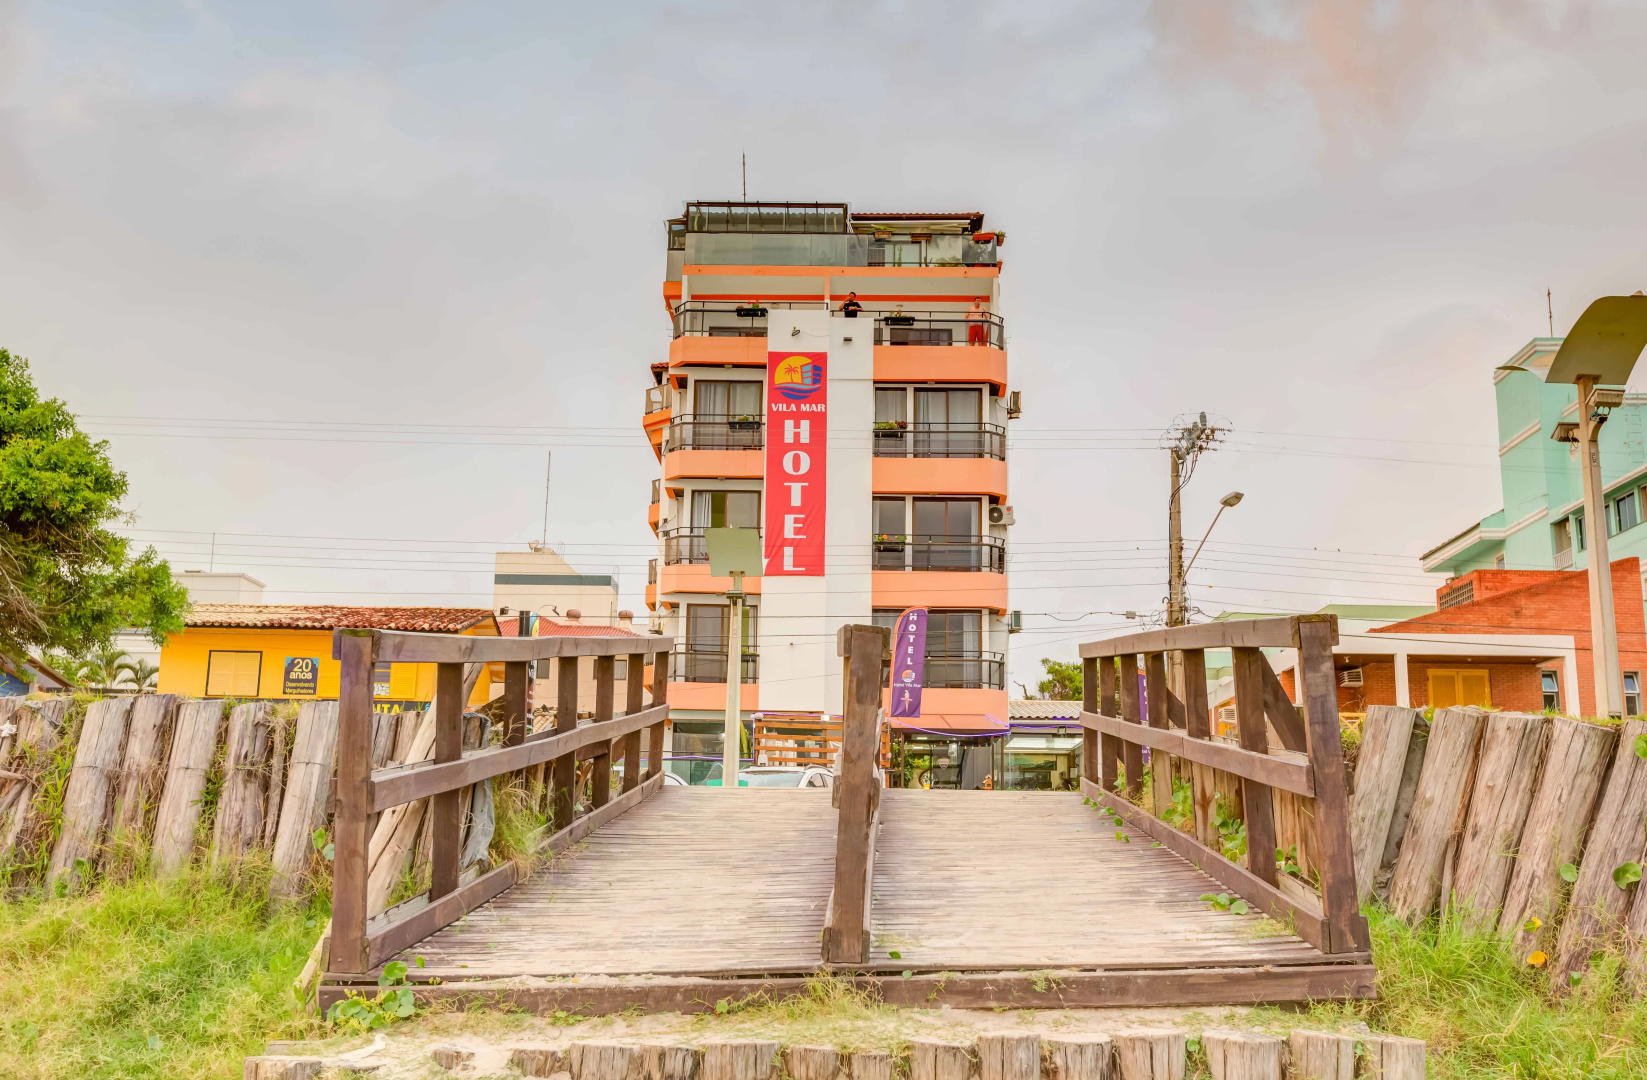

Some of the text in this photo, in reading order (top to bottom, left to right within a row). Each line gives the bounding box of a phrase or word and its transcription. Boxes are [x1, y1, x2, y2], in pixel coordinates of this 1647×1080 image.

[771, 403, 826, 412] VILA MAR
[782, 419, 811, 571] HOTEL
[907, 613, 917, 665] HOTEL
[293, 659, 312, 672] 20
